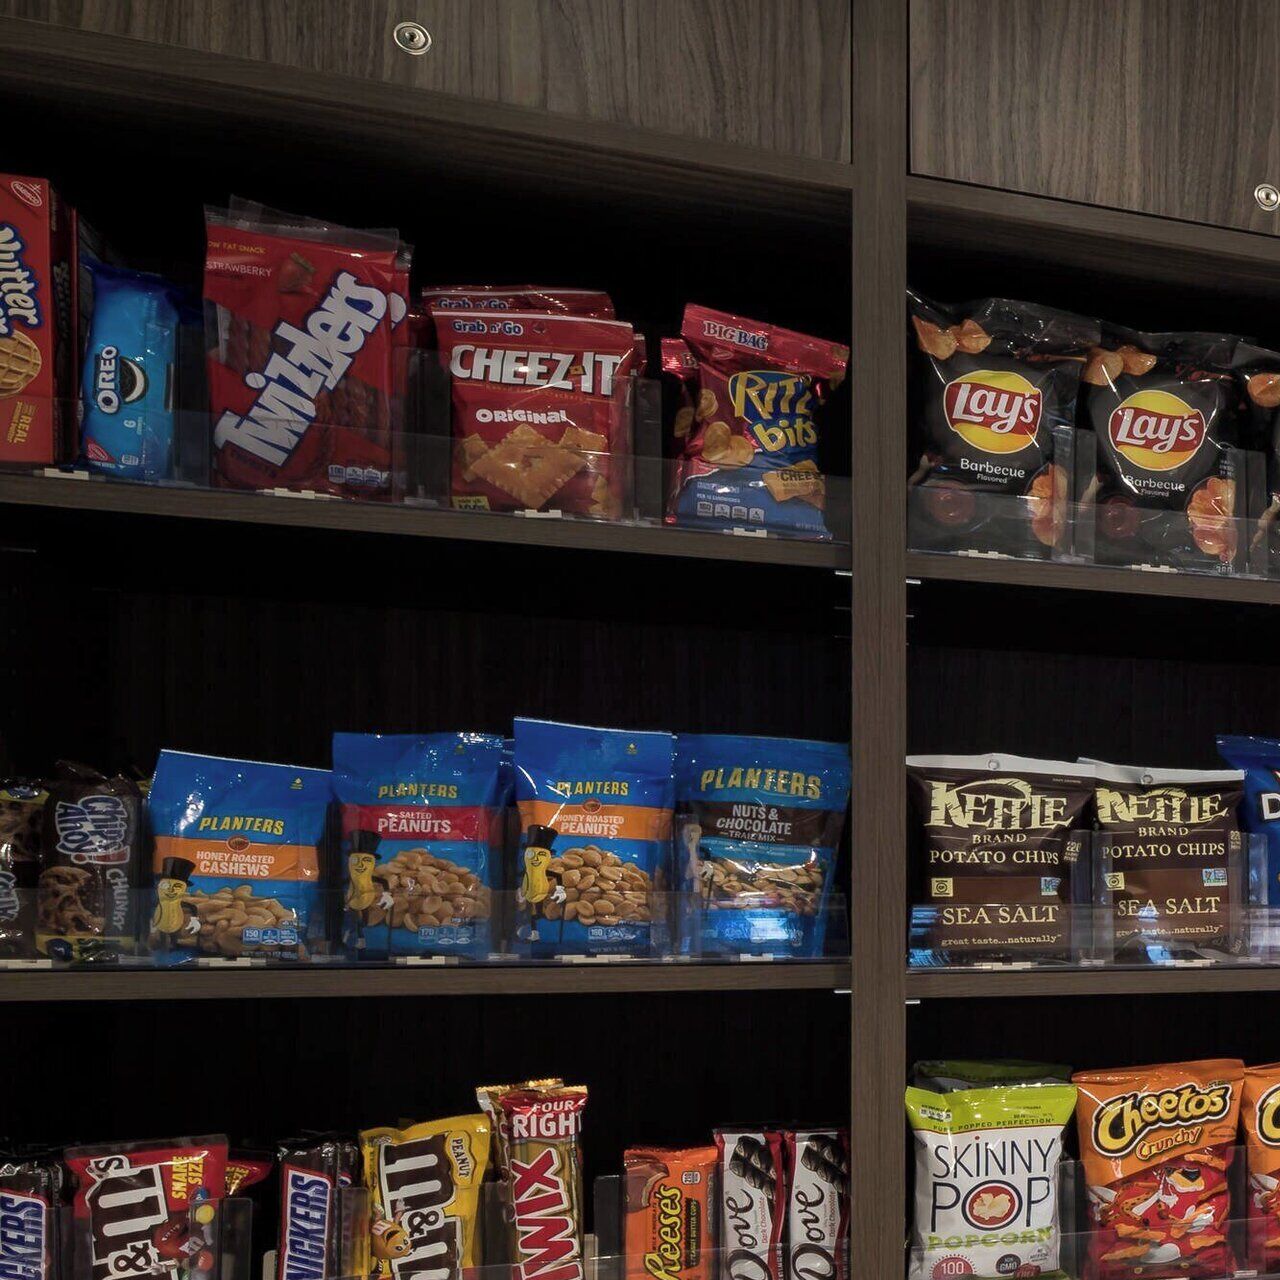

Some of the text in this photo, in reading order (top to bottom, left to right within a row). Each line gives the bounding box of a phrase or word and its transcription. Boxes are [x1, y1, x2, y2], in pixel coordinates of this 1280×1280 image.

[206, 261, 272, 277] STRAWBERRY
[453, 319, 523, 336] Grab Go
[703, 321, 768, 350] BIG BAG
[97, 346, 119, 414] OREO
[952, 383, 1039, 434] Lay's
[1116, 409, 1198, 454] Lay's
[960, 458, 1025, 478] Barbecue
[976, 473, 1008, 485] Flavored
[1125, 475, 1186, 493] Barbecue
[378, 782, 458, 800] PLANTERS
[556, 780, 629, 796] PLANTERS
[700, 766, 822, 801] PLANTERS
[399, 810, 432, 820] SALTED
[587, 815, 625, 825] ROASTED
[732, 804, 779, 821] NUTS &
[198, 815, 285, 836] PLANTERS
[378, 818, 452, 834] PEANUTS
[560, 823, 619, 836] PEANUTS
[716, 818, 792, 836] CHOCOLATE
[1138, 826, 1189, 837] BRAND
[972, 834, 1027, 845] BRAND
[197, 851, 275, 865] HONEY ROASTED
[930, 849, 1060, 866] POTATO CHIPS
[1101, 842, 1226, 860] POTATO CHIPS
[199, 860, 270, 877] CASHEWS
[942, 904, 1060, 927] SEA SALT
[1117, 896, 1221, 917] SEA SALT
[957, 1118, 1053, 1130] POPPED PERFECTION
[1096, 1086, 1228, 1151] Cheetos
[1136, 1125, 1204, 1161] Crunchy
[451, 1137, 473, 1179] PEANUT
[931, 1176, 1052, 1232] POP
[927, 1228, 1054, 1250] POPCORN
[941, 1261, 965, 1275] 100
